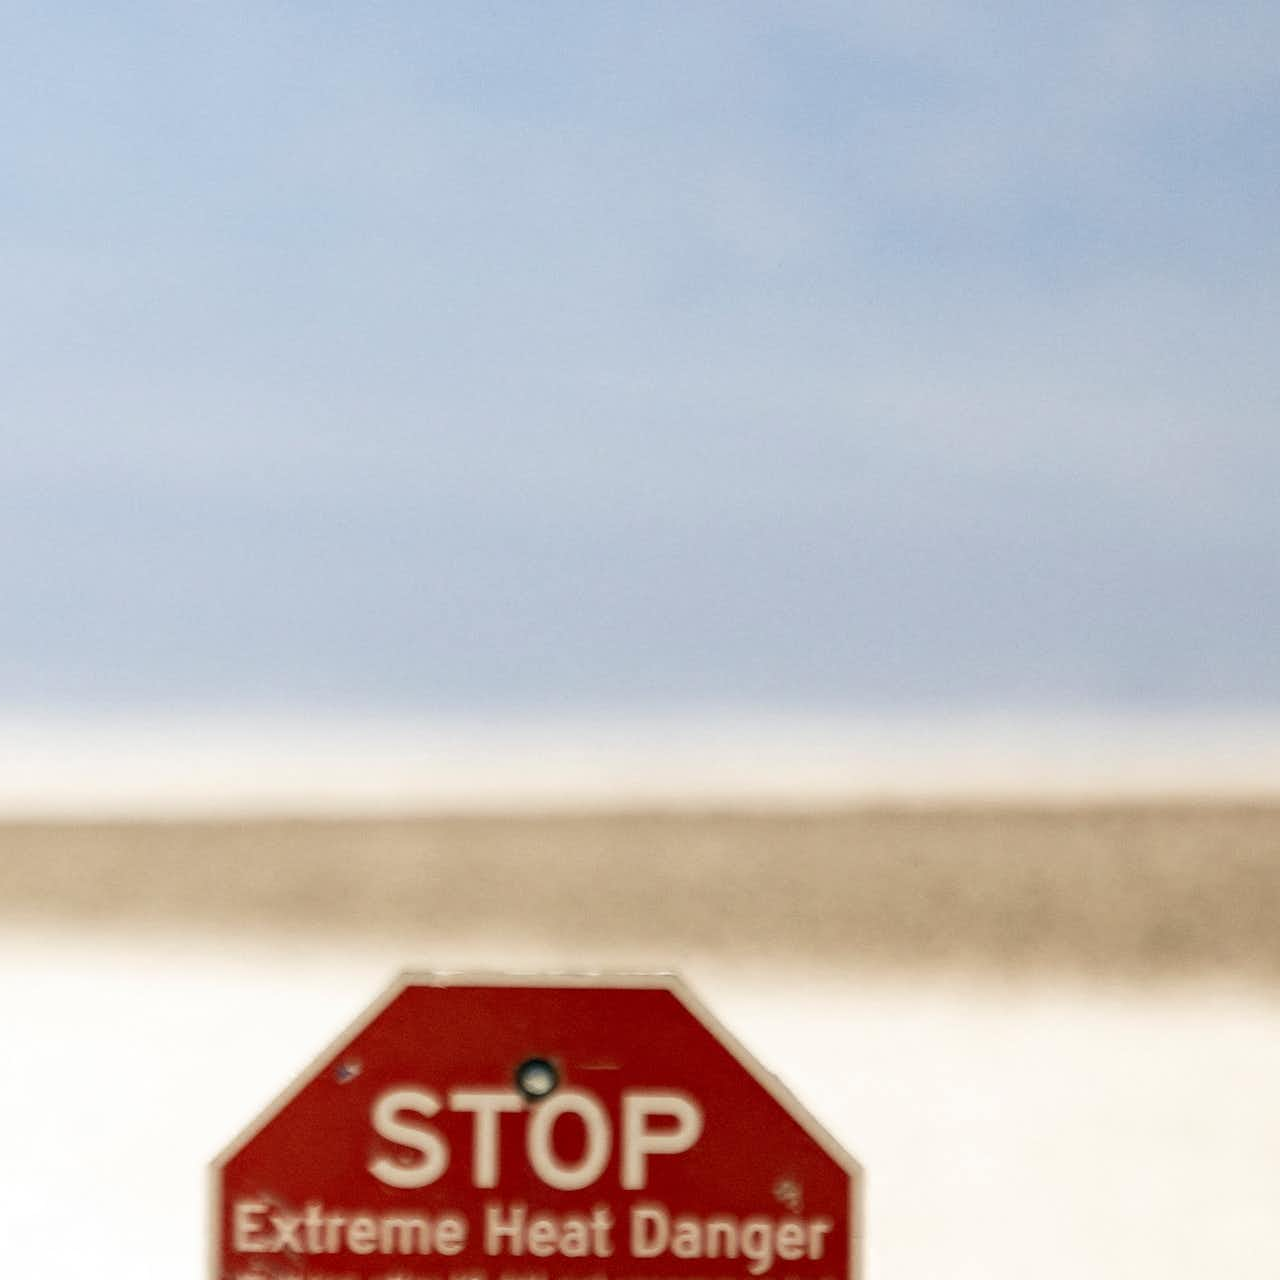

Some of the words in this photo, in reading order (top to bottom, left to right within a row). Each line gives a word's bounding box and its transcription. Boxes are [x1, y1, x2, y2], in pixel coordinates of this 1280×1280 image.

[369, 1090, 703, 1191] STOP
[232, 1202, 467, 1256] Extreme
[484, 1204, 613, 1258] Heat
[630, 1204, 833, 1275] Danger
